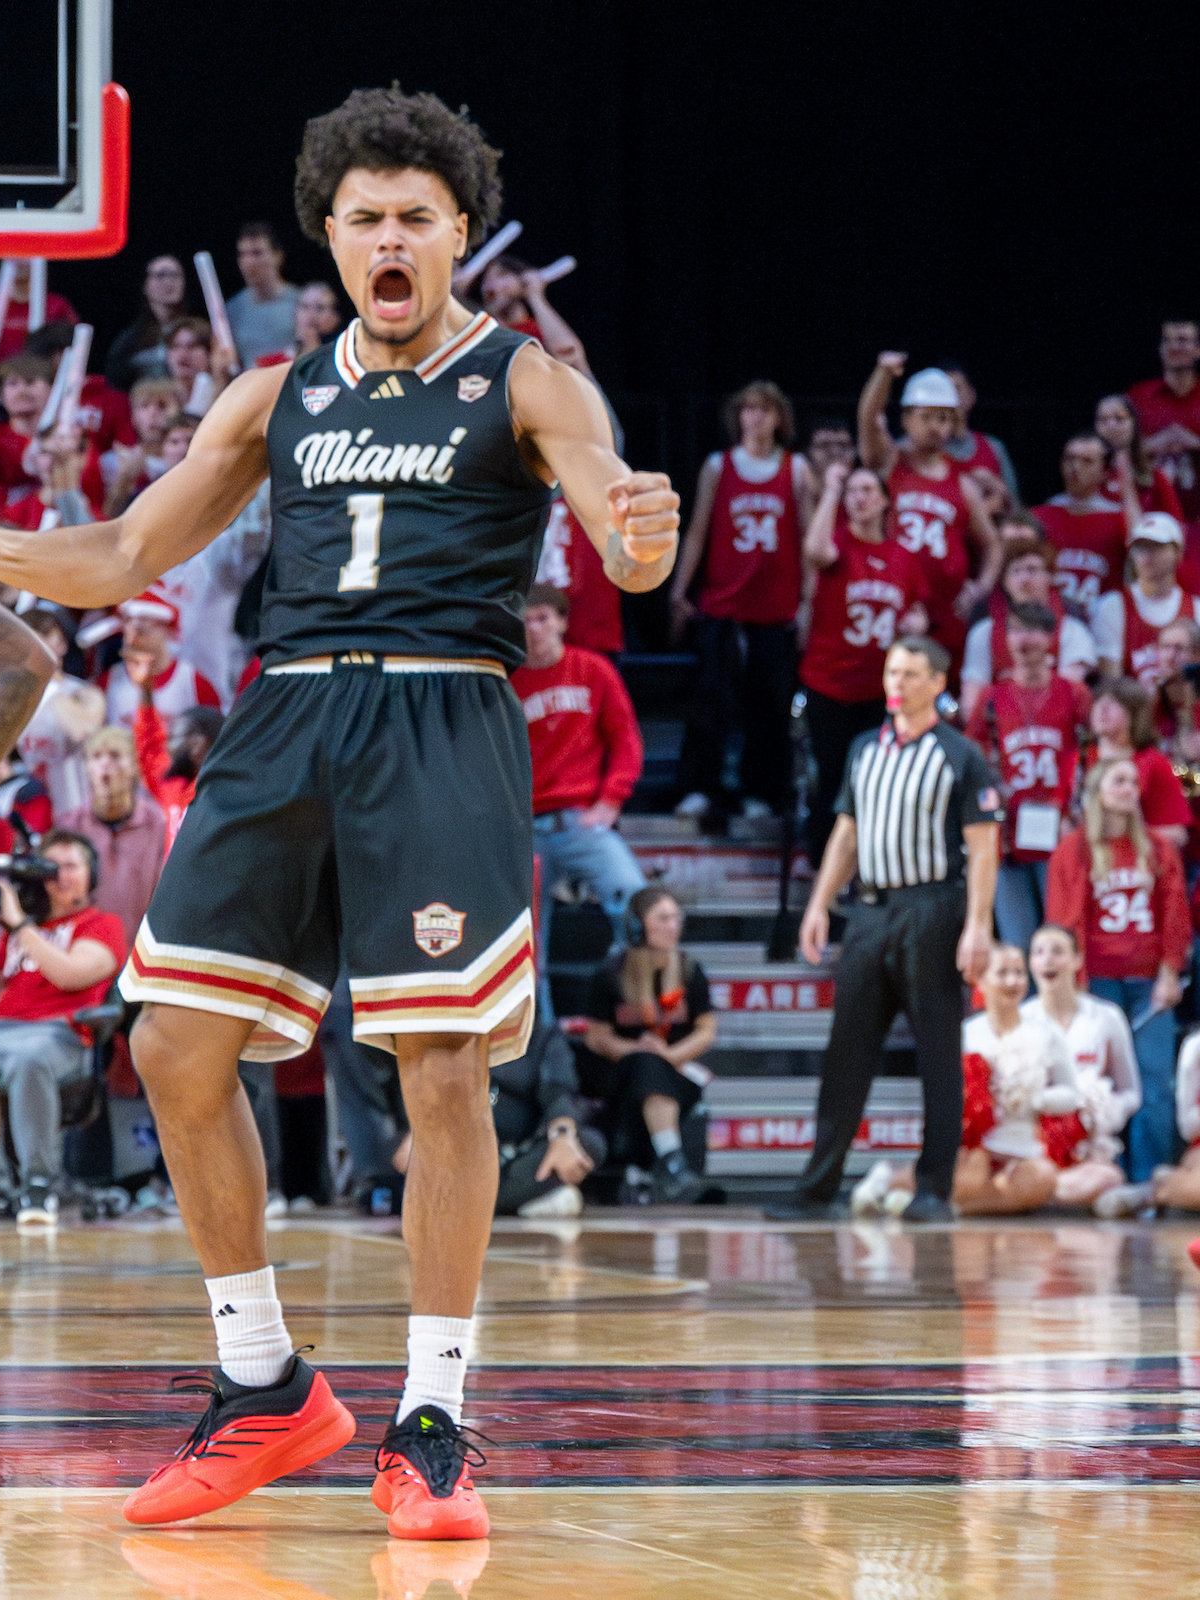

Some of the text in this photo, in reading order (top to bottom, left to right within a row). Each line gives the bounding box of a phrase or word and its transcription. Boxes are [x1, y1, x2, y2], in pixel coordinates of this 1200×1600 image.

[294, 427, 468, 489] Miami
[338, 493, 385, 592] 1
[732, 515, 778, 553] 34
[896, 511, 948, 560] 34
[842, 602, 897, 650] 34
[1008, 748, 1059, 790] 34
[1099, 891, 1155, 934] 34
[745, 982, 818, 1010] ARE
